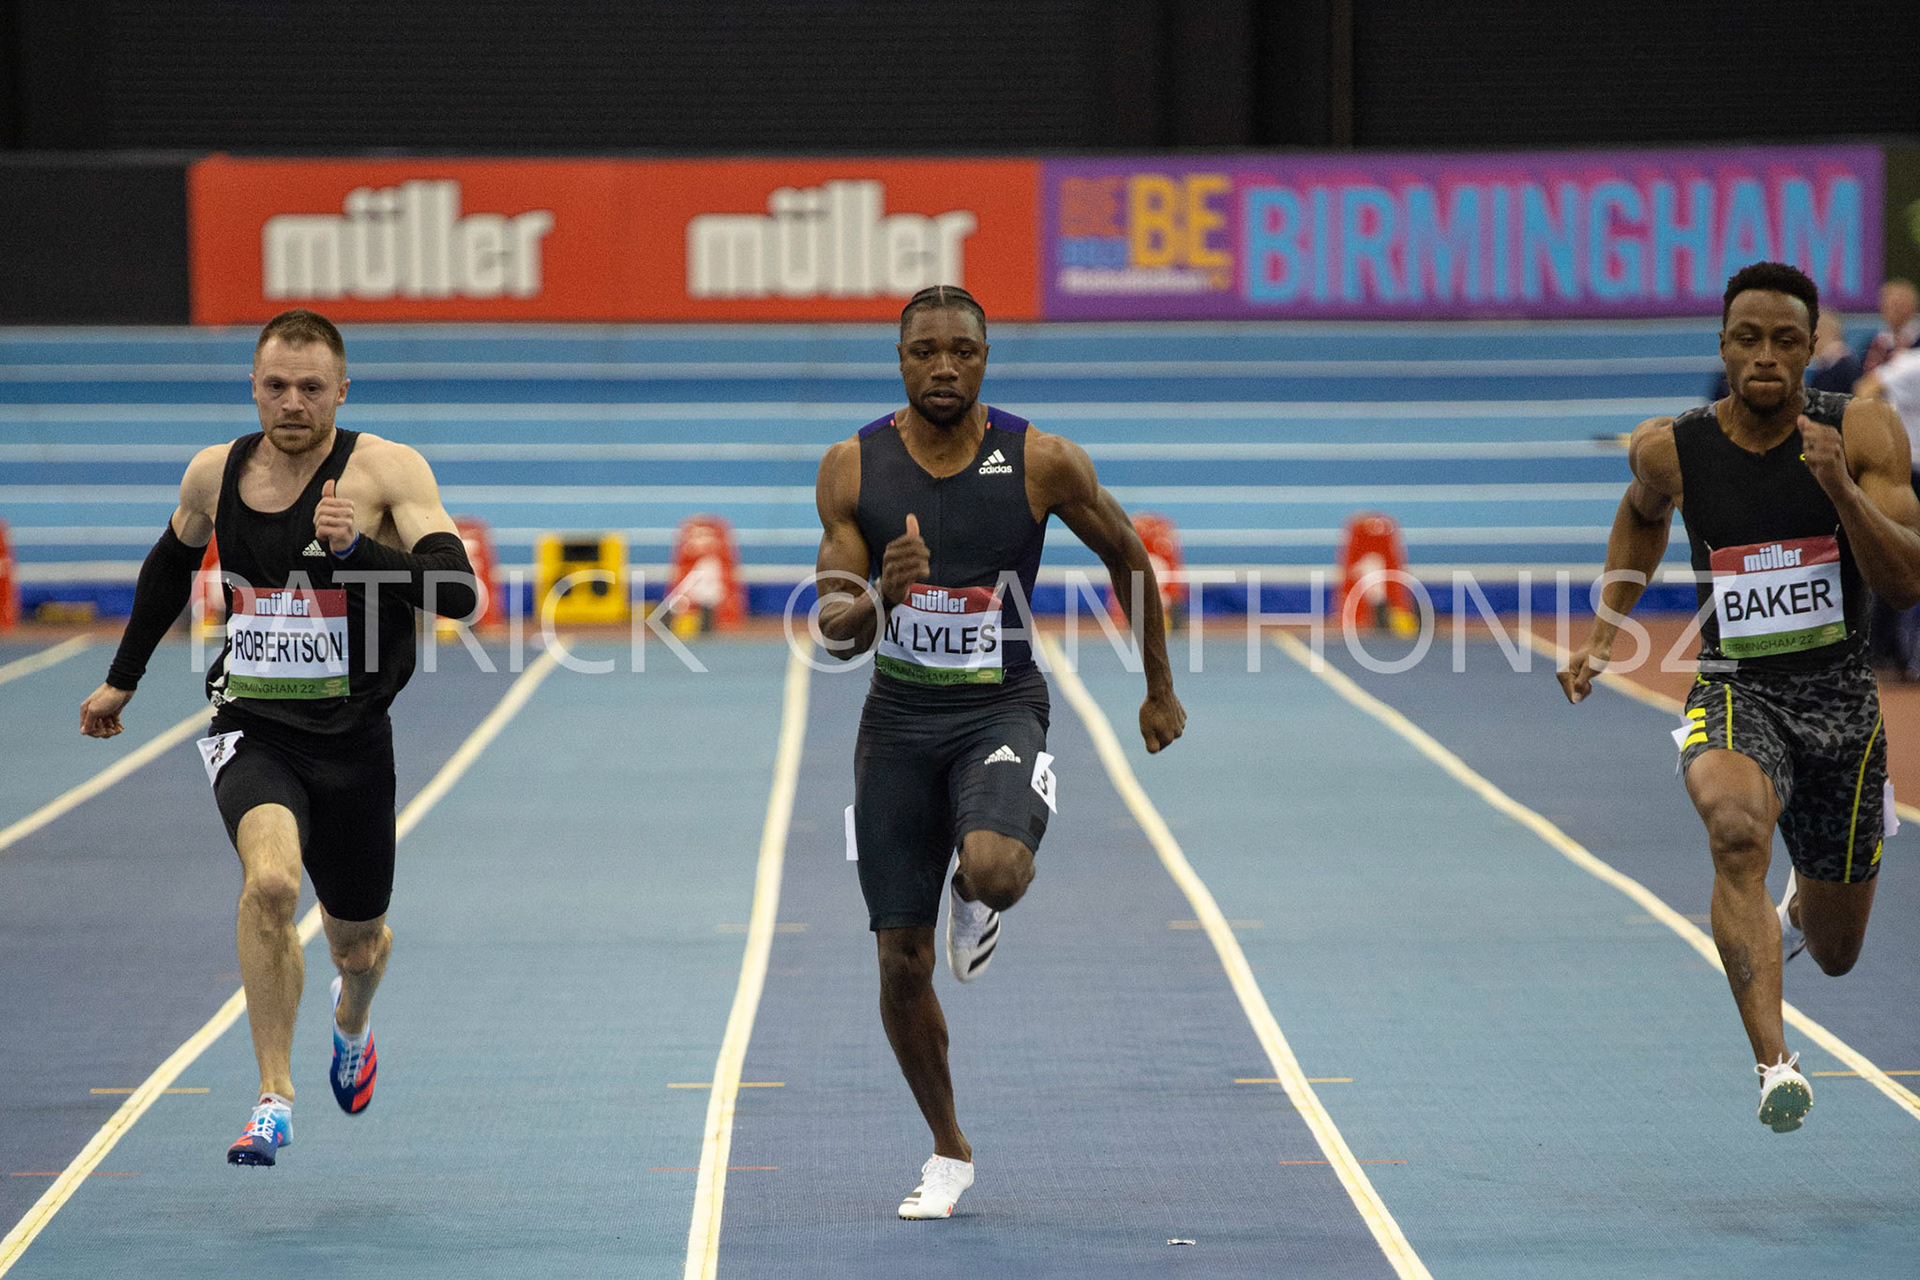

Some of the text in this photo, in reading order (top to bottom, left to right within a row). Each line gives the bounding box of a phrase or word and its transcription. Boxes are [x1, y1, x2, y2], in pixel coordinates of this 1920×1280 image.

[263, 179, 555, 299] müller
[687, 179, 978, 298] müller
[1243, 179, 1864, 303] BIRMINGHAM
[979, 465, 1013, 475] adidas
[1744, 544, 1802, 572] müller
[255, 592, 310, 616] müller
[911, 590, 967, 613] müller
[1724, 579, 1833, 622] BAKER
[235, 630, 343, 663] ROBERTSON
[913, 623, 997, 655] LYLES
[1799, 634, 1814, 646] 22
[299, 684, 316, 694] 22
[952, 673, 968, 683] 22
